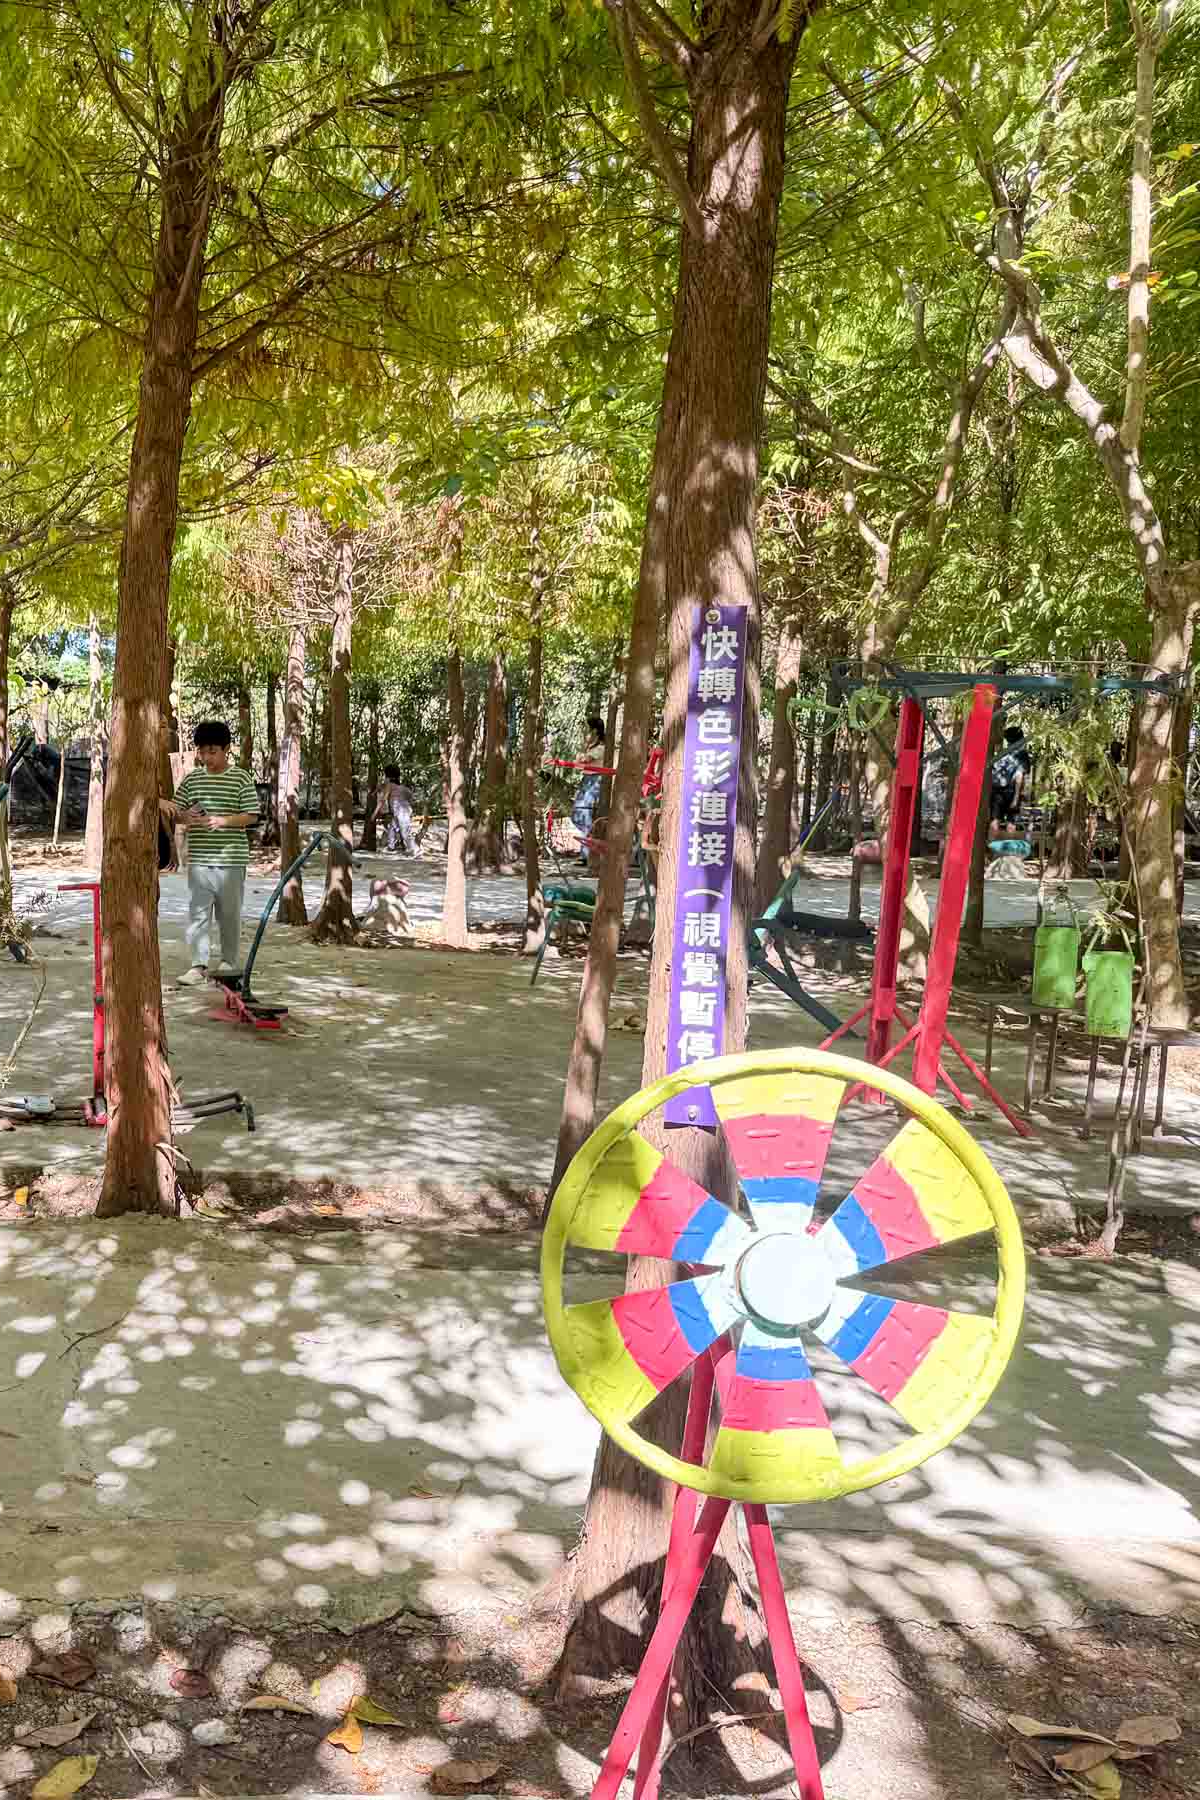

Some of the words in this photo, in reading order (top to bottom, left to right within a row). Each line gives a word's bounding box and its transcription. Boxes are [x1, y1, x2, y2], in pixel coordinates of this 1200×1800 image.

[677, 626, 738, 1087] 快轉色彩連接（視覺暫停
